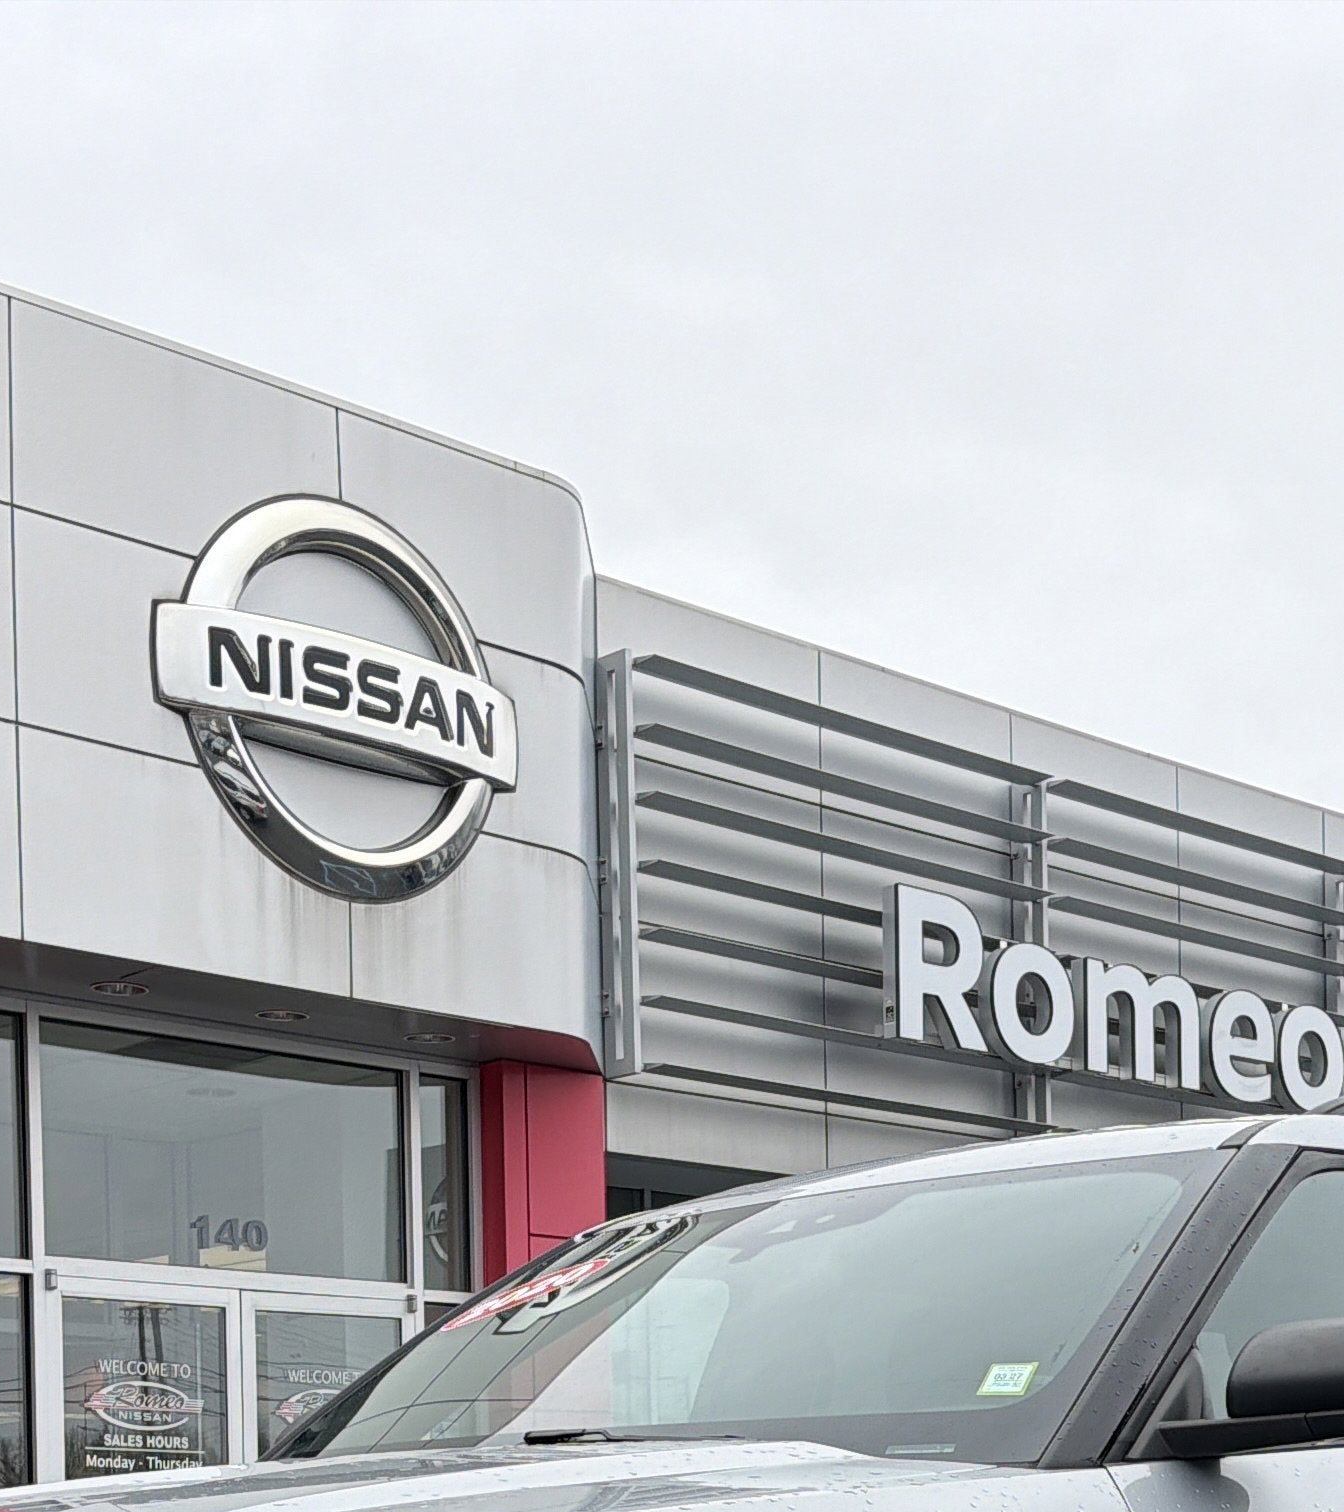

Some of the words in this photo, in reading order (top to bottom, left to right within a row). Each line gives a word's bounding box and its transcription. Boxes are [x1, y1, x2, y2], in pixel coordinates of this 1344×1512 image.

[207, 625, 496, 759] NISSAN
[884, 882, 1344, 1112] Romeo
[190, 1214, 268, 1252] 140
[98, 1359, 167, 1377] WELCOME
[171, 1363, 191, 1379] TO
[287, 1369, 350, 1385] WELCOME
[109, 1384, 186, 1409] Romeo
[118, 1411, 172, 1422] NISSAN
[103, 1433, 144, 1447] SALES
[146, 1436, 189, 1449] HOURS
[85, 1454, 136, 1471] Monday
[146, 1456, 203, 1470] Thursday
